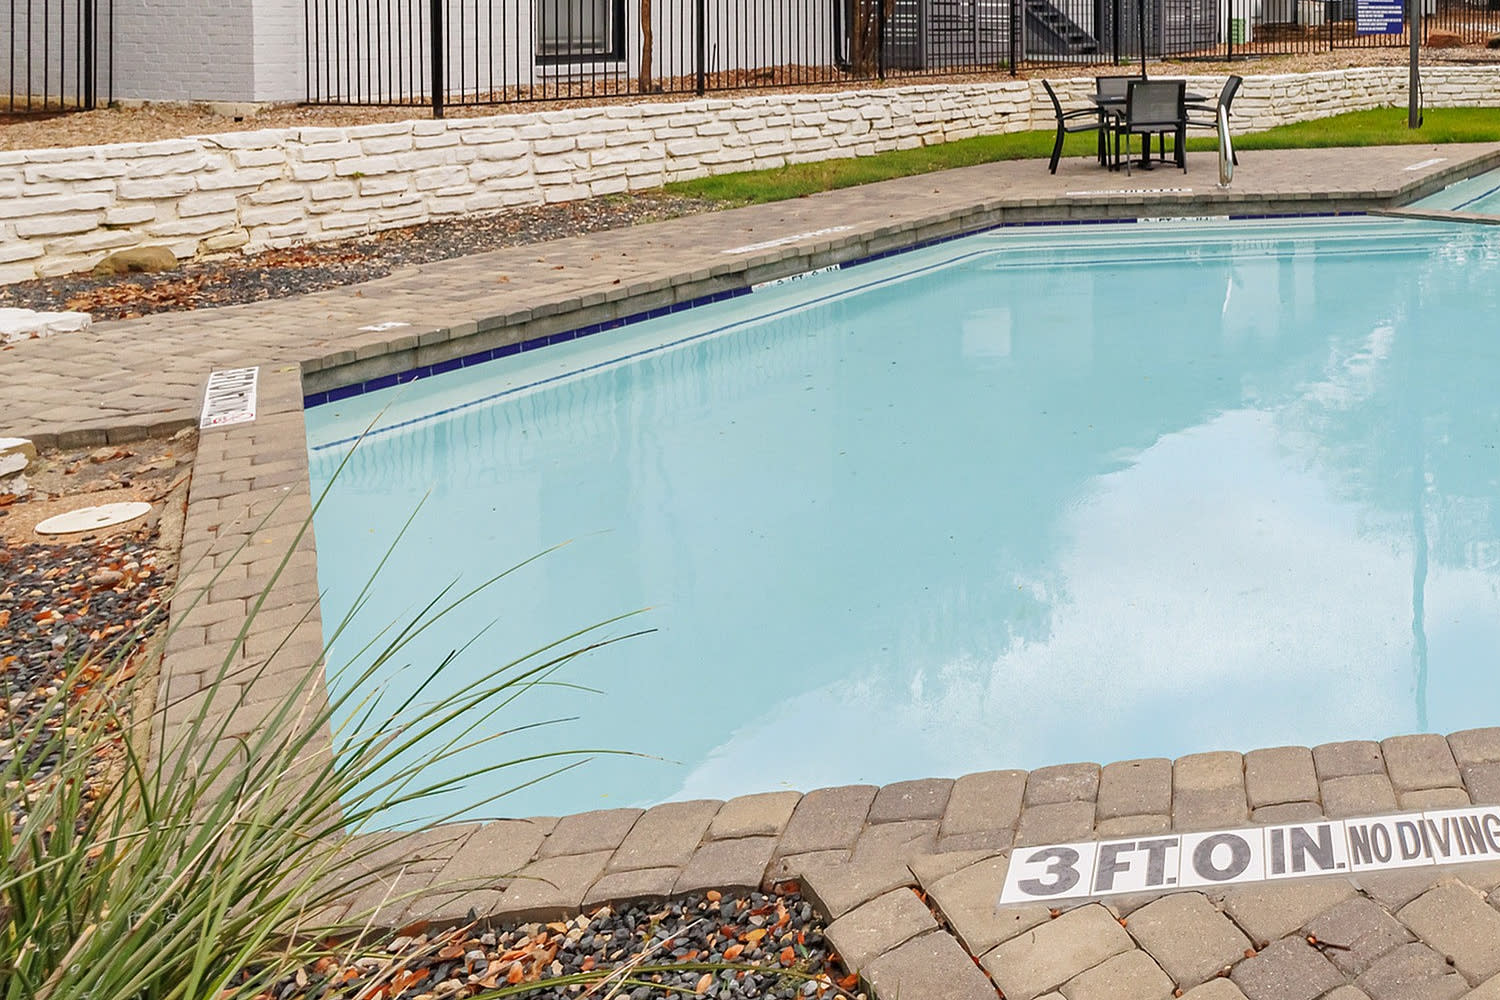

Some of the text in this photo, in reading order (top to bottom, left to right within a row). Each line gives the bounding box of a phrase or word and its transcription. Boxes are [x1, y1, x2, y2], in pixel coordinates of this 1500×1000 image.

[1018, 847, 1080, 897] 3
[1094, 838, 1179, 892] FT.
[1271, 825, 1346, 874] IN.
[1348, 823, 1392, 865] NO
